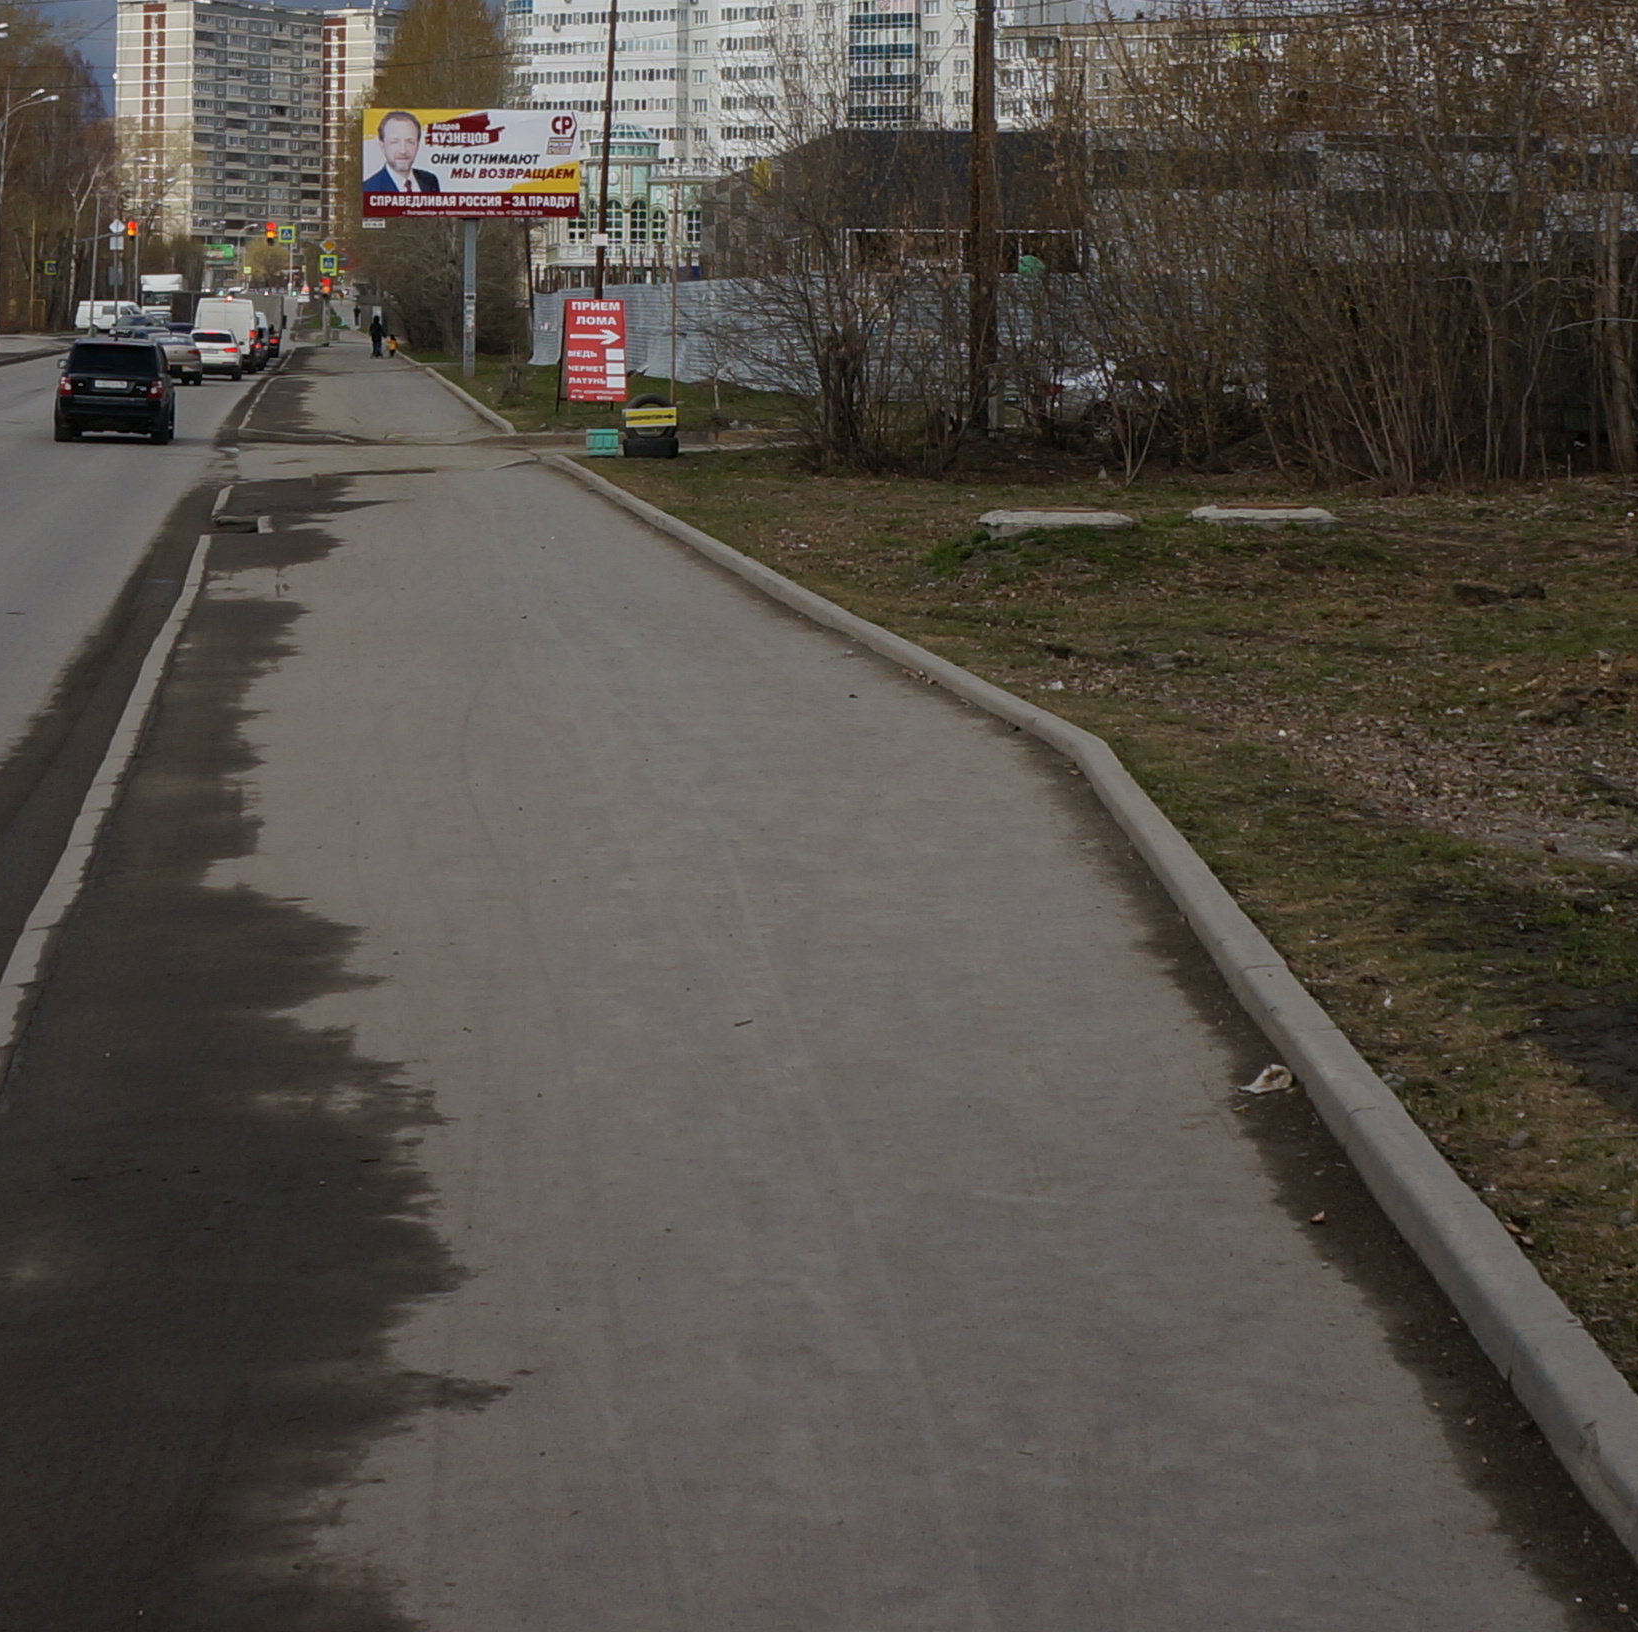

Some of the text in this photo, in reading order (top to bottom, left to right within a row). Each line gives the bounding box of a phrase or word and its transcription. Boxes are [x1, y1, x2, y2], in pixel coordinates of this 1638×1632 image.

[431, 122, 461, 132] Андрей
[551, 116, 573, 135] СР
[431, 131, 490, 145] КУЗНЕЦОВ
[430, 153, 541, 166] ОНИ ОТНИМАЮТ
[450, 168, 576, 181] МЫ ВОЗВРАЩАЕМ
[369, 194, 458, 208] СПРАВЕДЛИВАЯ
[459, 195, 502, 208] РОССИЯ
[512, 195, 526, 208] ЗА
[528, 195, 576, 209] ПРАВДУ!
[571, 301, 621, 311] ПРИЕМ
[575, 315, 617, 326] ЛОМА
